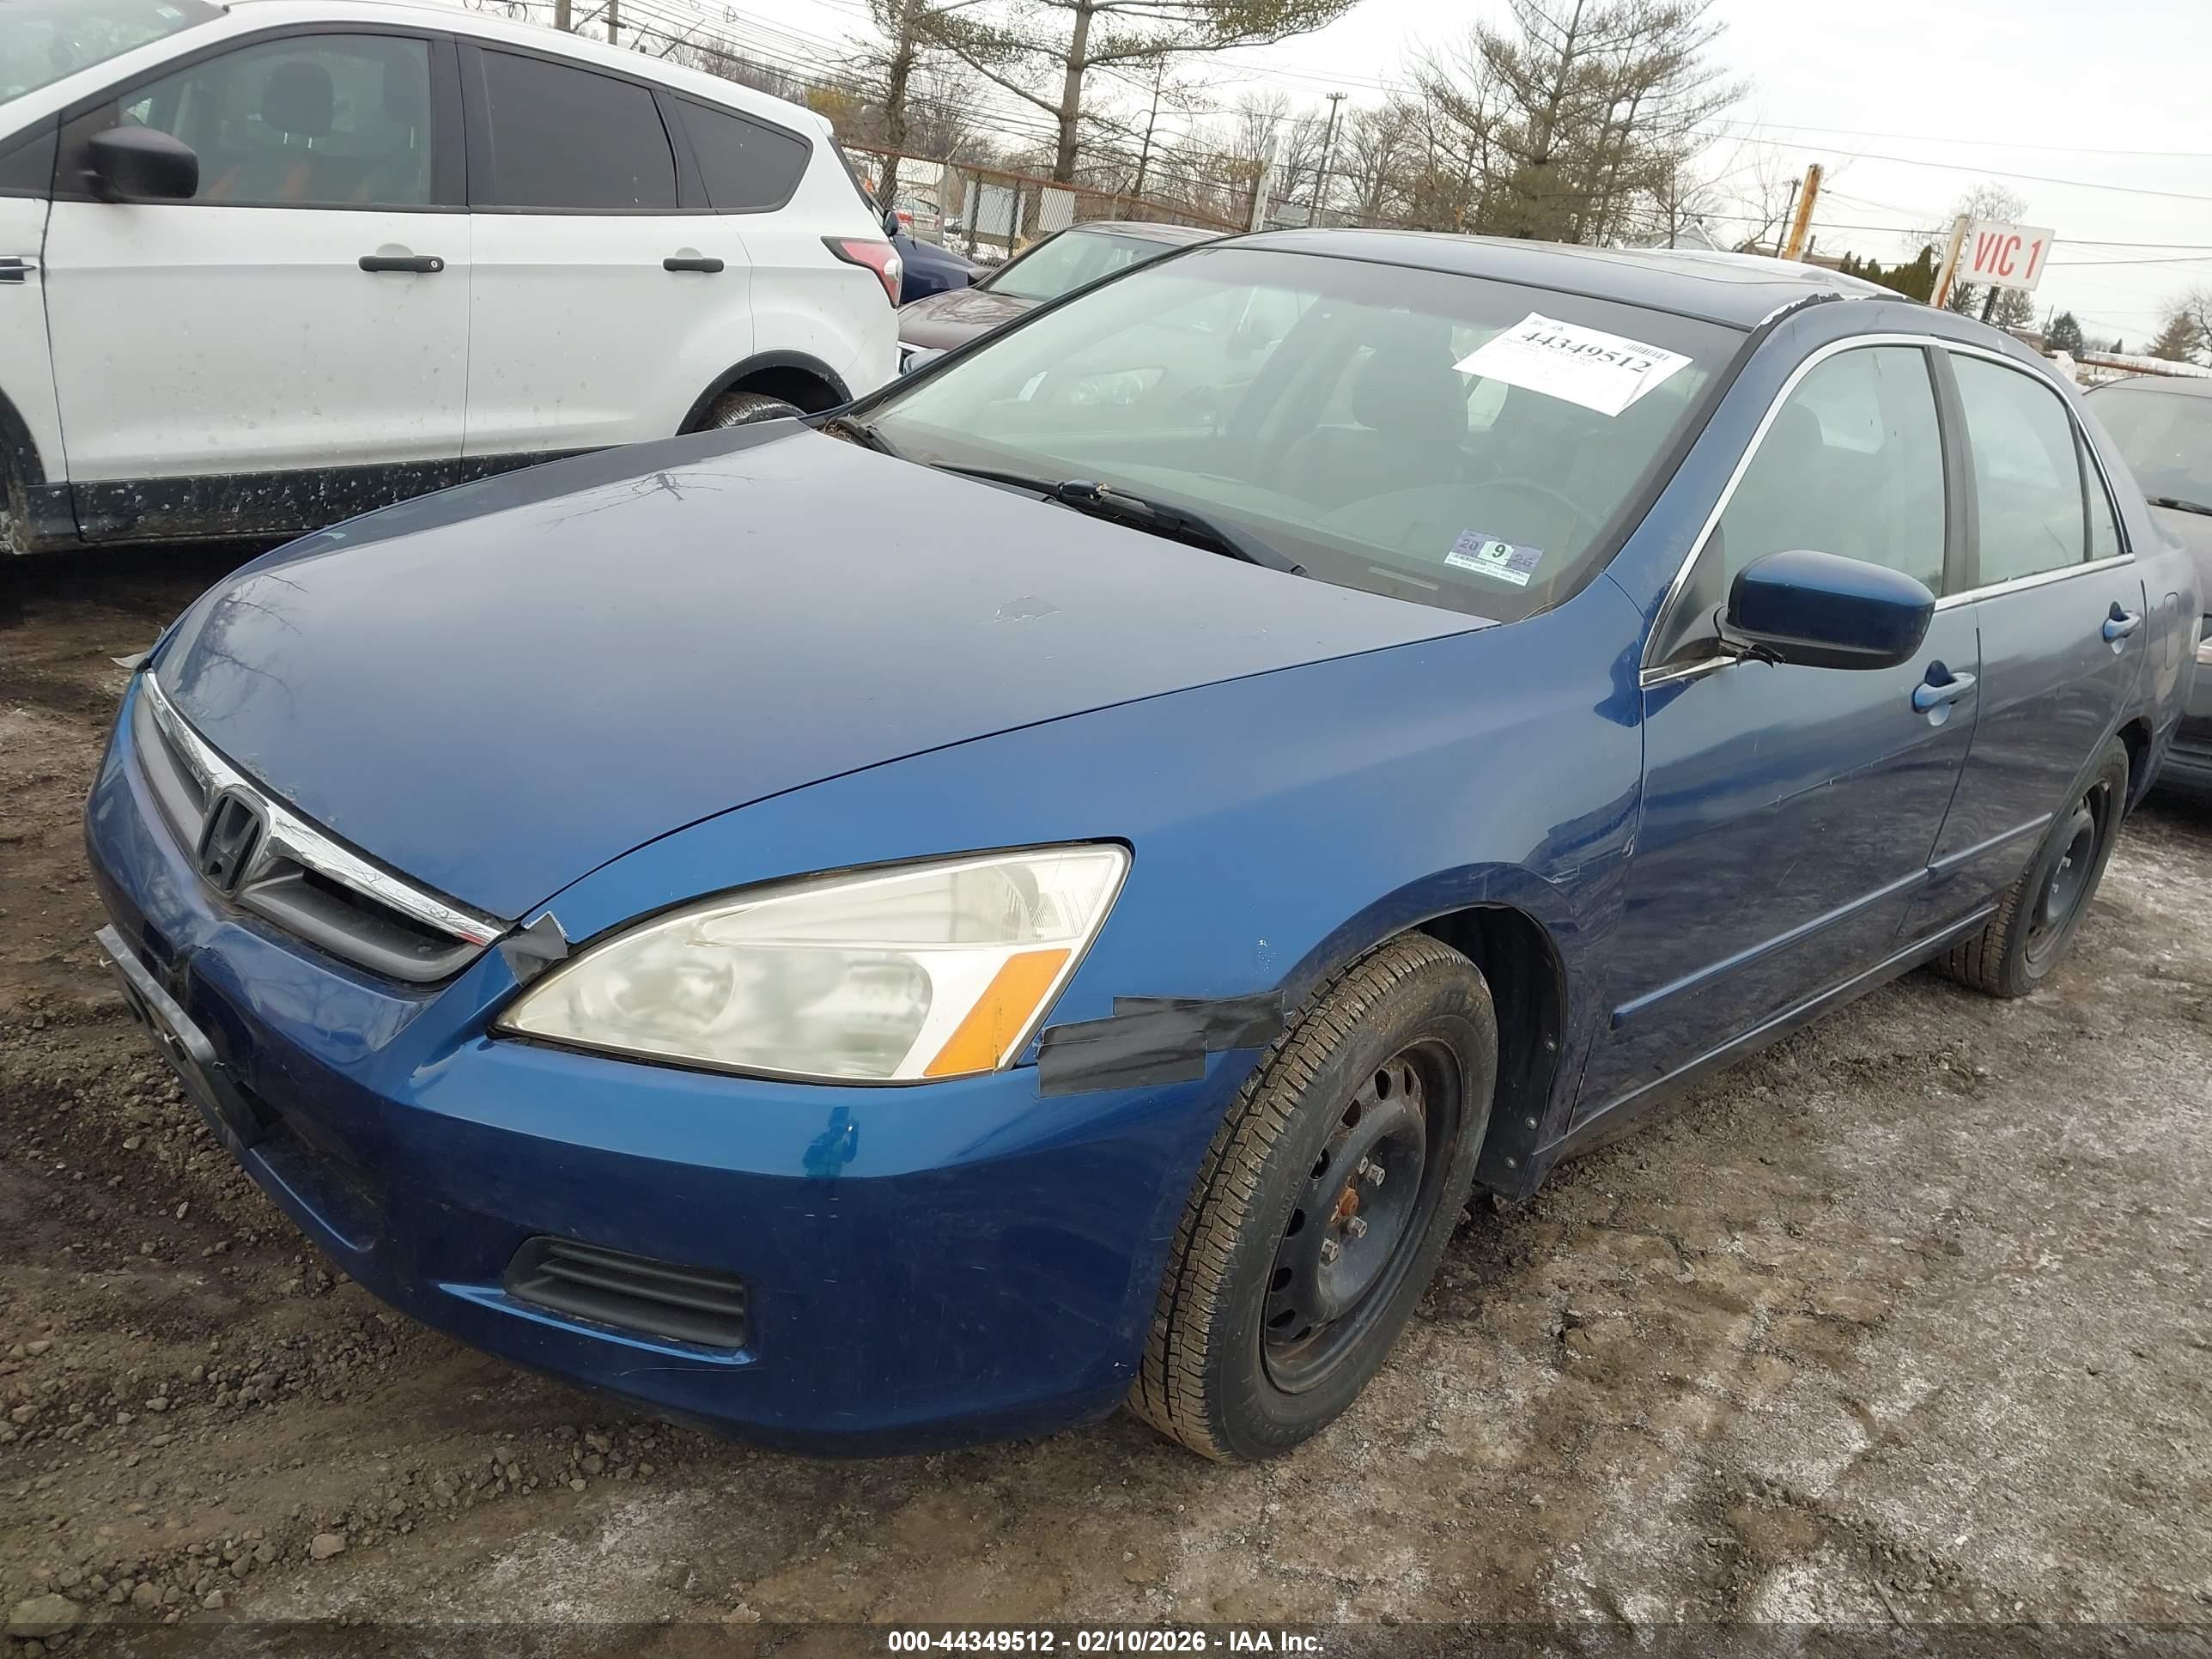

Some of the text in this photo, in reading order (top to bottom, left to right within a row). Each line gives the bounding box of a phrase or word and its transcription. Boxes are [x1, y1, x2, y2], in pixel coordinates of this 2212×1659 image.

[1973, 232, 2044, 279] VIC 1
[1521, 331, 1652, 373] 44349512
[1492, 544, 1506, 558] 9
